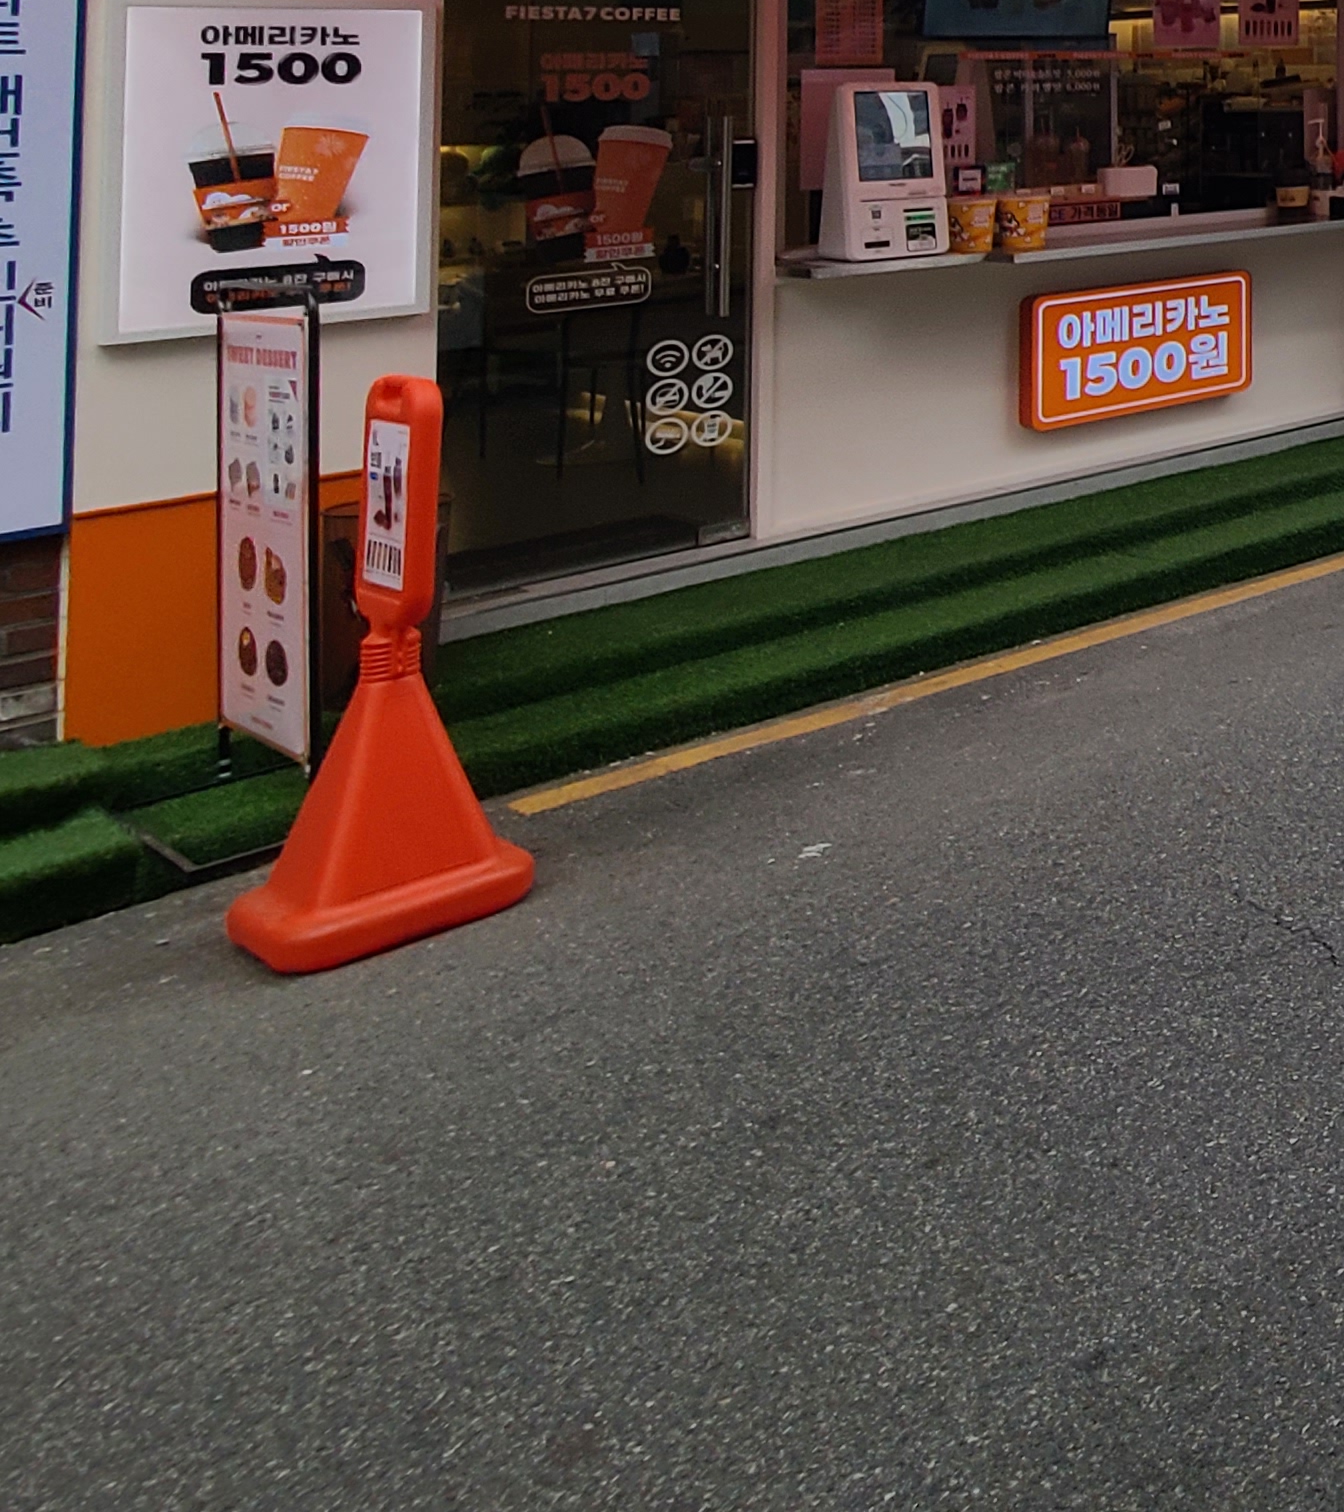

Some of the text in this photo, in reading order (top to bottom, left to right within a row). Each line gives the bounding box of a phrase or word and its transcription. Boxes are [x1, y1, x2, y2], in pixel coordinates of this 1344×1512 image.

[505, 5, 681, 21] FIESTA7 COFFEE
[200, 25, 361, 47] 아메리카노
[200, 51, 362, 86] 1500
[540, 72, 651, 103] 1500
[271, 202, 291, 212] or
[279, 221, 337, 235] 1500원
[596, 232, 644, 246] 1500원
[1058, 295, 1230, 349] 아메리카노
[1058, 331, 1229, 401] 1500원
